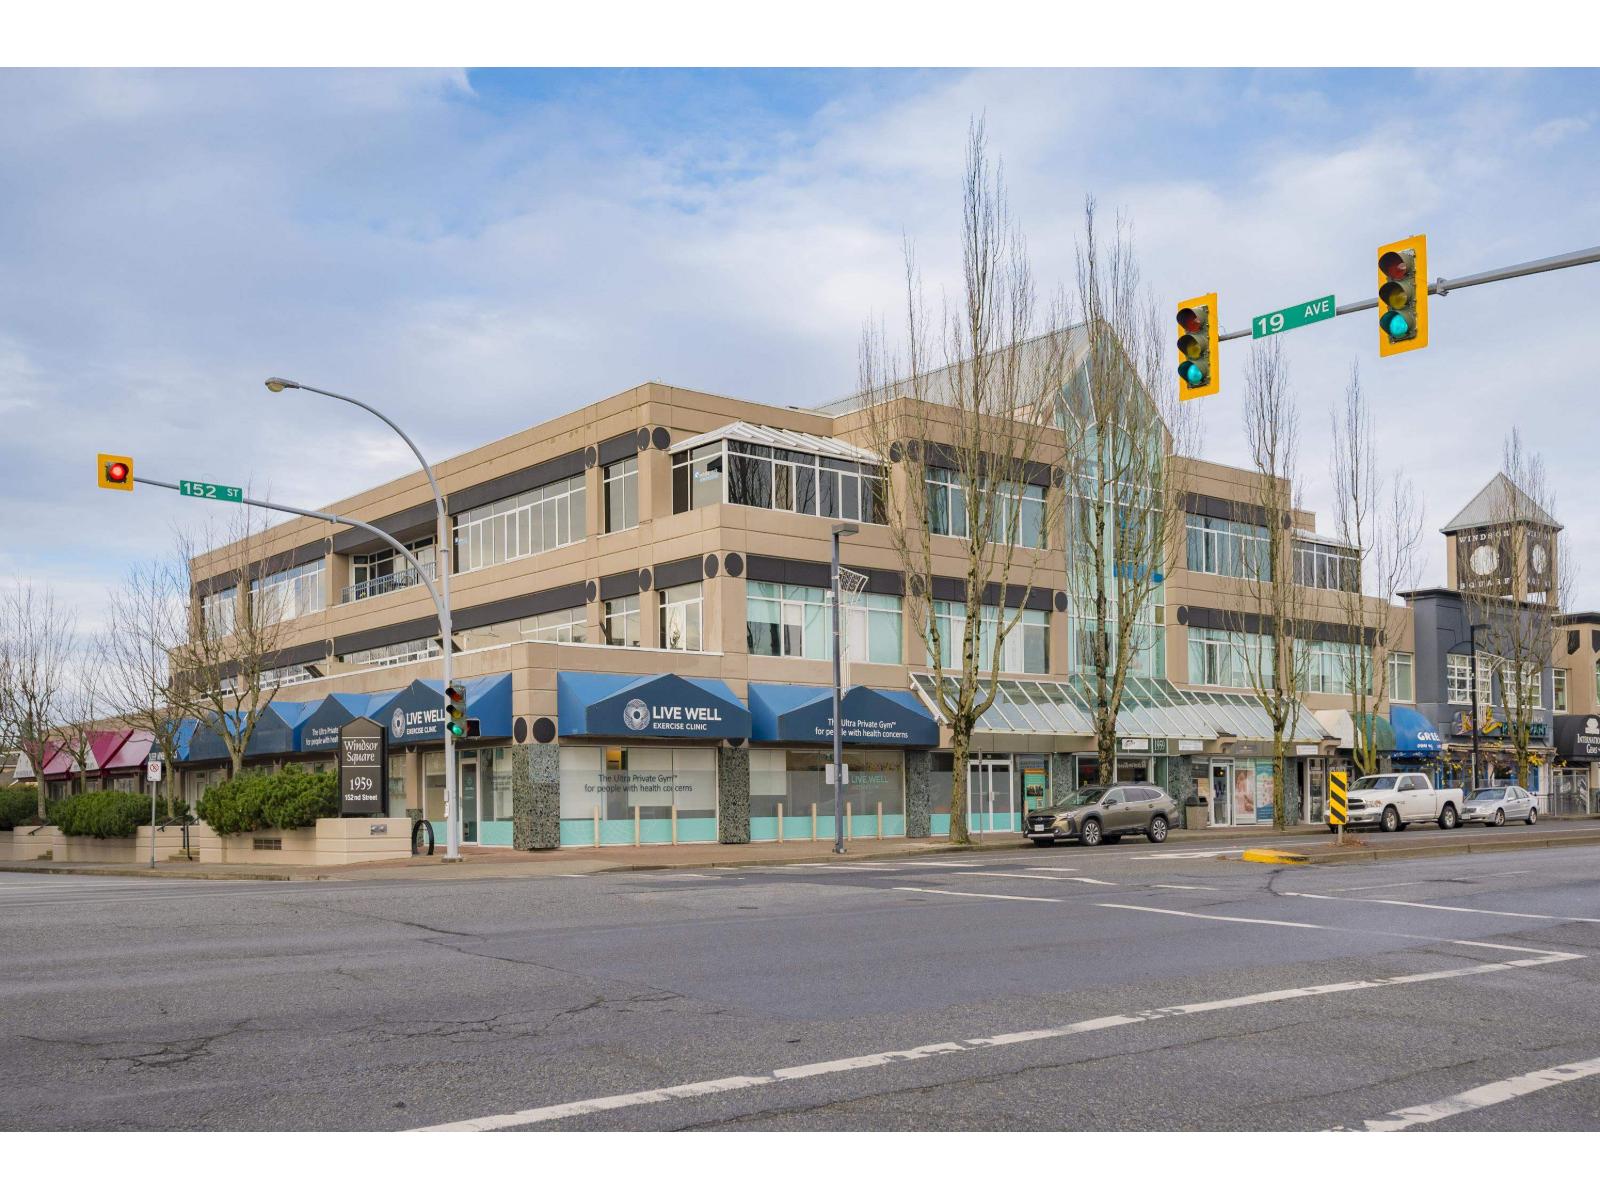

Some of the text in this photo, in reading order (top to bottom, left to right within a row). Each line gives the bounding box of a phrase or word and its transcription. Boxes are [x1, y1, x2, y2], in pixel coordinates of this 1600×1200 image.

[1258, 300, 1329, 335] 19 AVE
[183, 482, 239, 498] 152 ST
[406, 709, 446, 725] LIVE WELL
[652, 705, 722, 721] LIVE WELL
[406, 725, 437, 735] EXERCISE CLINIC
[653, 722, 707, 731] EXERCISE CLINIC
[857, 720, 878, 729] Private
[815, 727, 824, 735] for
[848, 729, 861, 737] with
[862, 729, 881, 738] health
[882, 731, 909, 739] concerns
[343, 739, 378, 751] Windsor
[346, 751, 375, 765] Square
[350, 776, 373, 791] 1959
[598, 774, 612, 782] The
[613, 774, 631, 782] Ultra
[632, 774, 657, 783] Private
[851, 775, 889, 784] LIVE WELL
[584, 783, 595, 792] for
[597, 784, 621, 793] people
[622, 784, 639, 793] with
[640, 783, 662, 793] health
